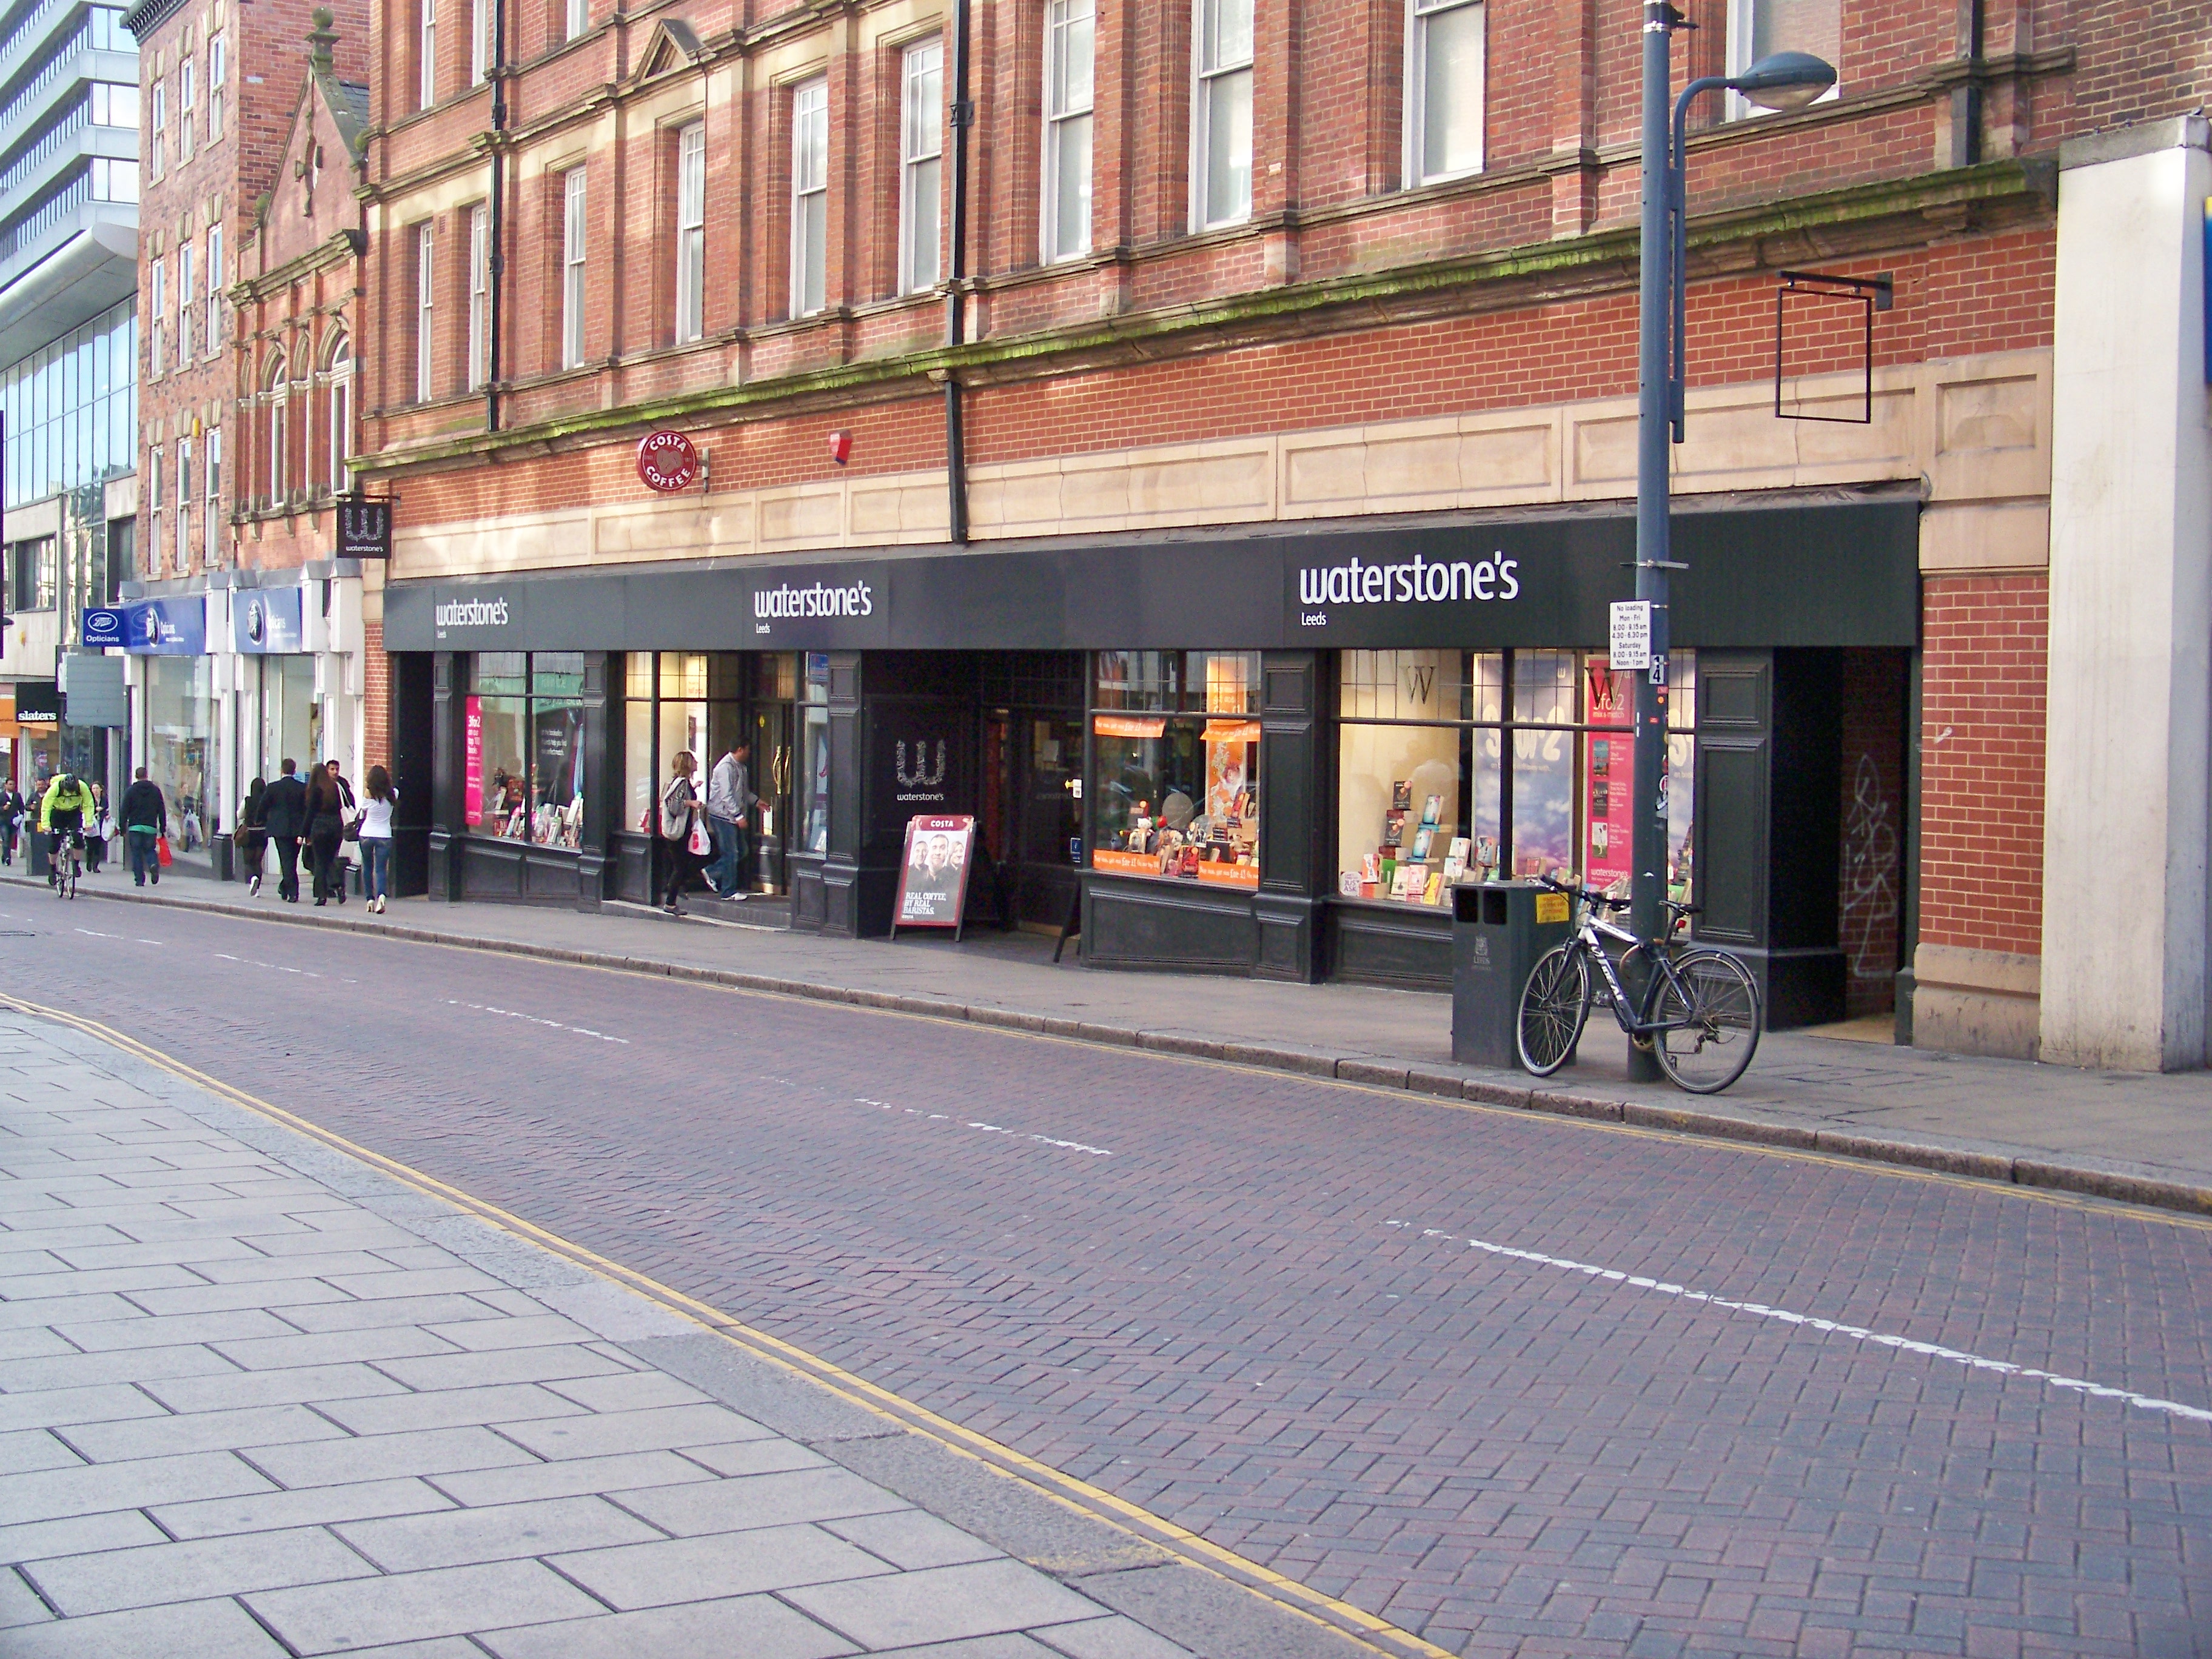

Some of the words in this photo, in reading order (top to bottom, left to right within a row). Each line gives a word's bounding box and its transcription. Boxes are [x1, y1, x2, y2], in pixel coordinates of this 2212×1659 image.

[649, 435, 686, 452] COSTA
[646, 466, 691, 487] COFFEE
[1299, 550, 1519, 605] waterstone's
[754, 580, 873, 618] waterstone's
[436, 597, 509, 626] waterstone's
[1301, 611, 1327, 626] Leeds
[756, 623, 771, 634] Leeds
[18, 711, 56, 721] slaters
[897, 793, 944, 801] waterstone's
[1590, 868, 1628, 877] waterstone's
[906, 891, 922, 900] REAL
[923, 892, 947, 901] COFFEE,
